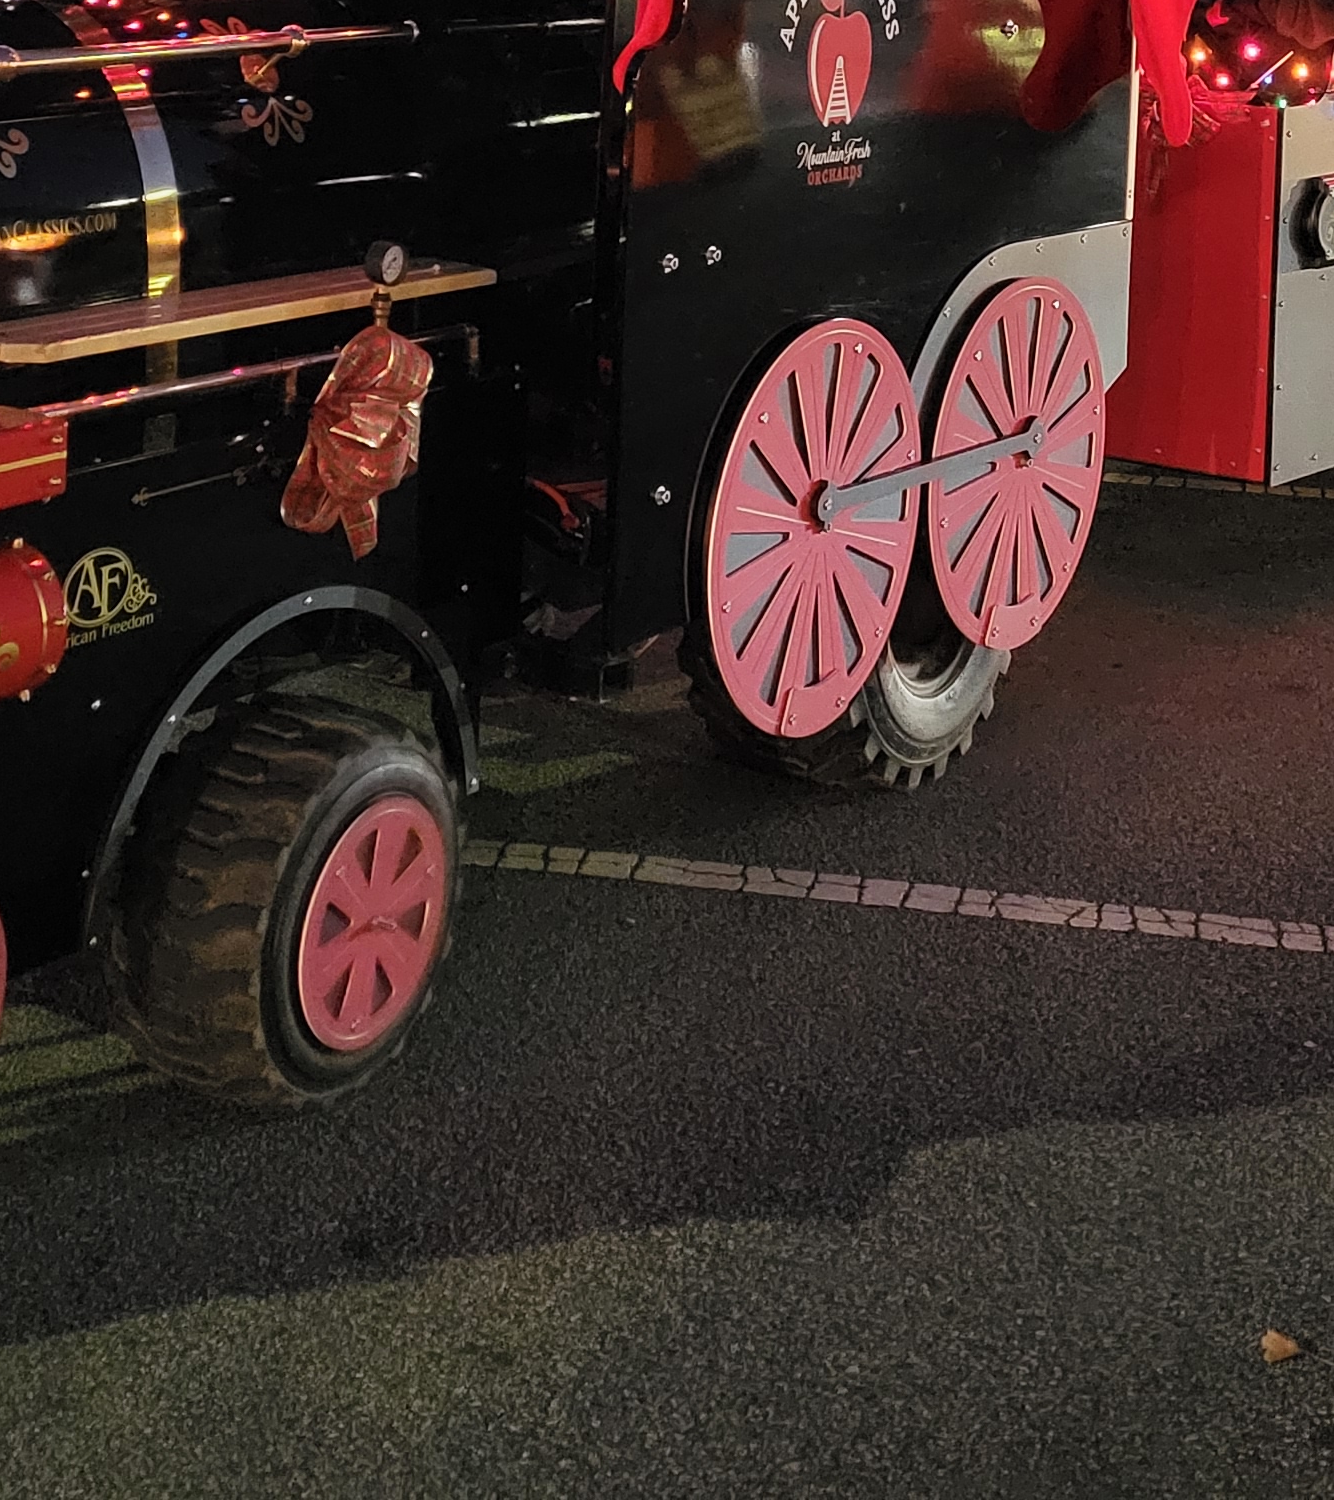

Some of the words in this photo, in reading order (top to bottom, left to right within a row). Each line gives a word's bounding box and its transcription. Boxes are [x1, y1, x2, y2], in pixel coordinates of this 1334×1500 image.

[830, 130, 841, 143] at
[807, 164, 863, 186] ORCHARDS
[65, 629, 97, 649] rican
[102, 613, 154, 638] Freedom
